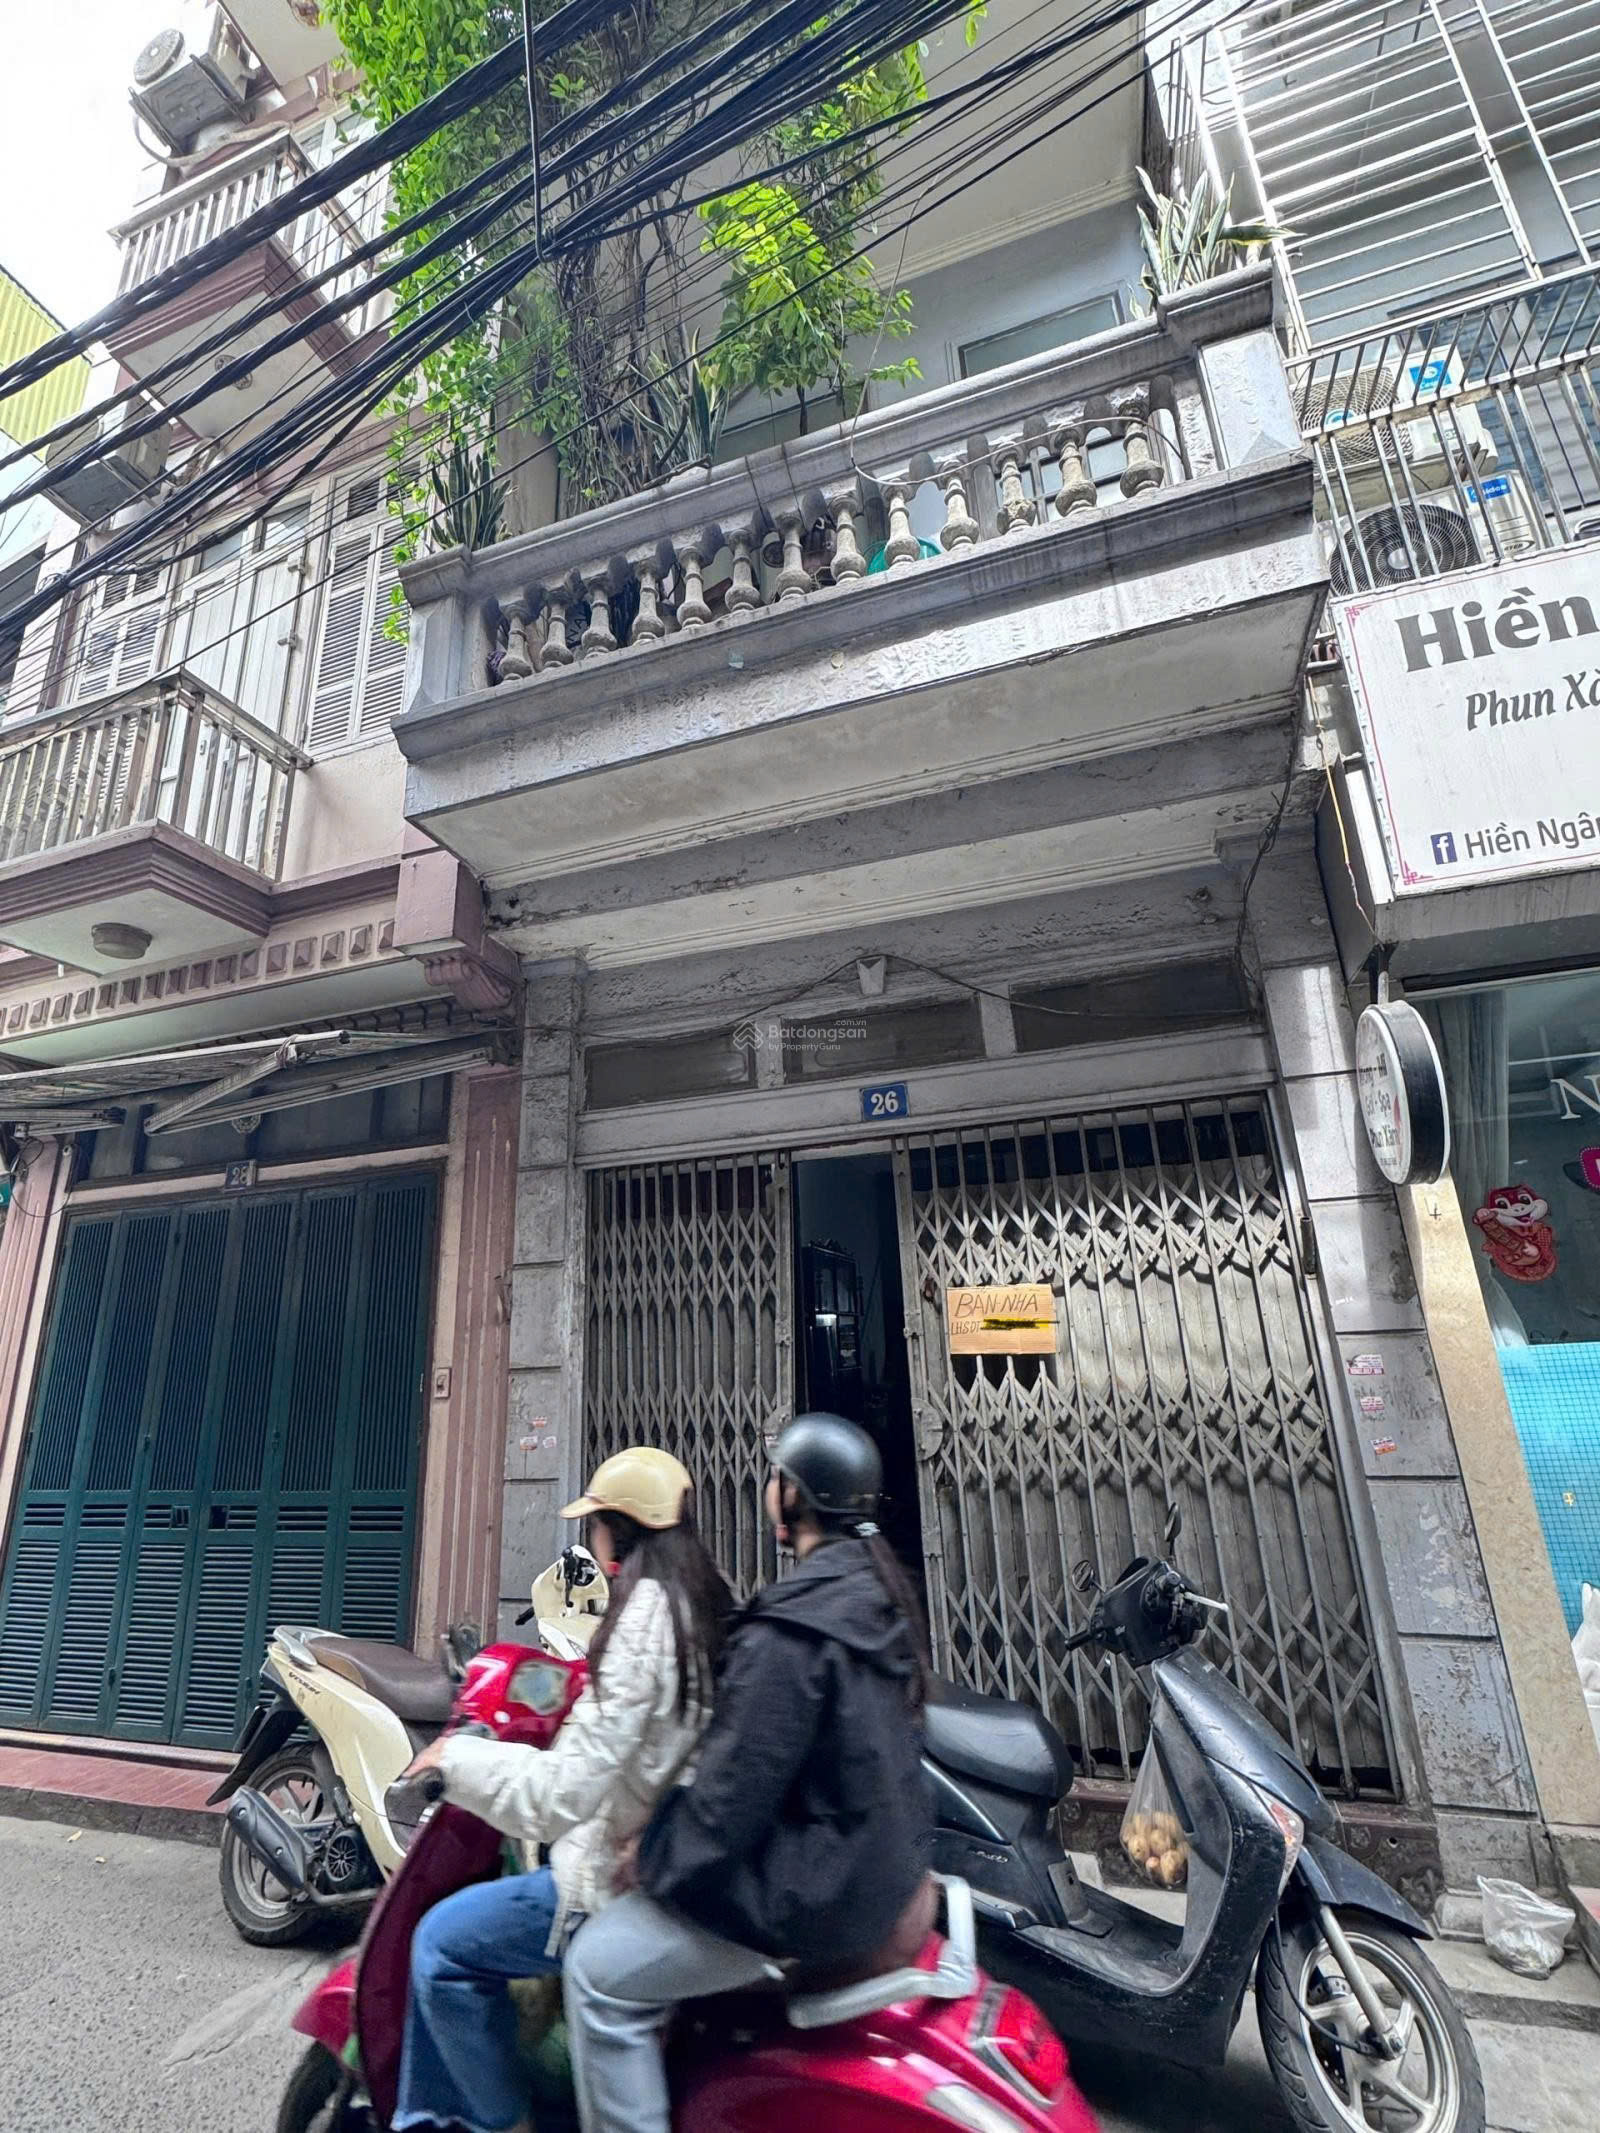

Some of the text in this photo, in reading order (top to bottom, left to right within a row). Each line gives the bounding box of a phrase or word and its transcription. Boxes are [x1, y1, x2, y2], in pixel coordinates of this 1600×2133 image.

[1395, 586, 1600, 673] Hiền
[1466, 687, 1556, 731] Phun
[1464, 822, 1531, 859] Hiền
[1536, 811, 1600, 849] Ngâ
[871, 1091, 899, 1116] 26
